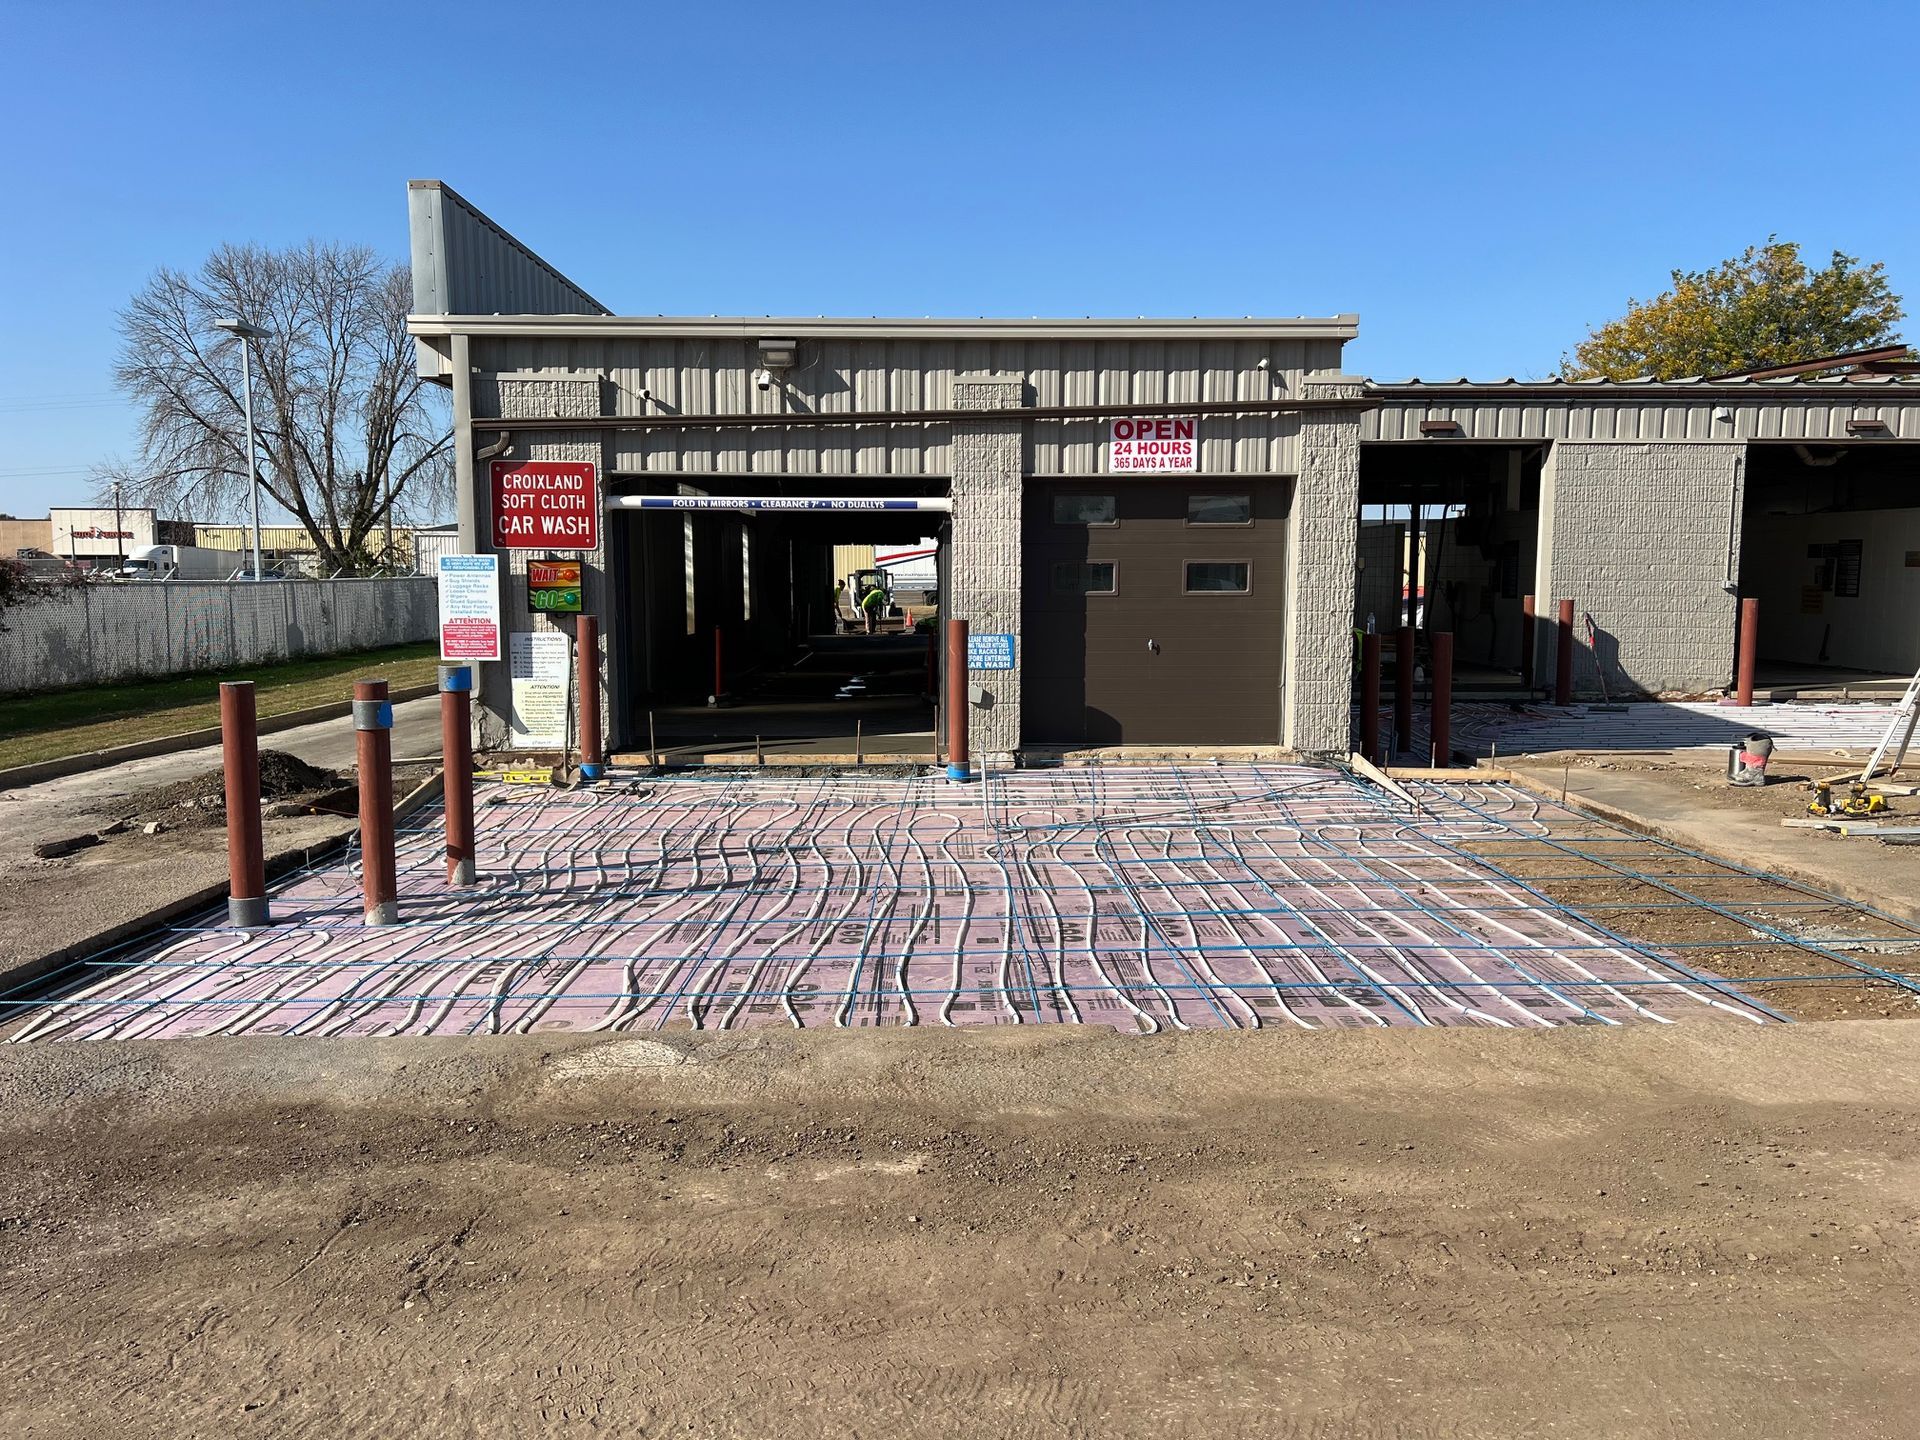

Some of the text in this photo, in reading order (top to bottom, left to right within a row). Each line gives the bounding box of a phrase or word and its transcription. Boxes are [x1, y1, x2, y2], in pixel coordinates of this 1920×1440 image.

[1114, 420, 1193, 440] OPEN
[1114, 442, 1192, 455] 24 HOURS
[1114, 457, 1192, 468] 365 DAYS A YEAR
[503, 474, 583, 490] CROIXLAND
[501, 494, 585, 510] SOFT CLOTH
[672, 499, 885, 509] FOLD IN MIRRORS CLEARANCE 7' NO DUALLYS
[499, 515, 590, 535] CAR WASH
[532, 568, 559, 582] WAIT
[535, 590, 558, 609] GO
[968, 635, 981, 643] LEASE
